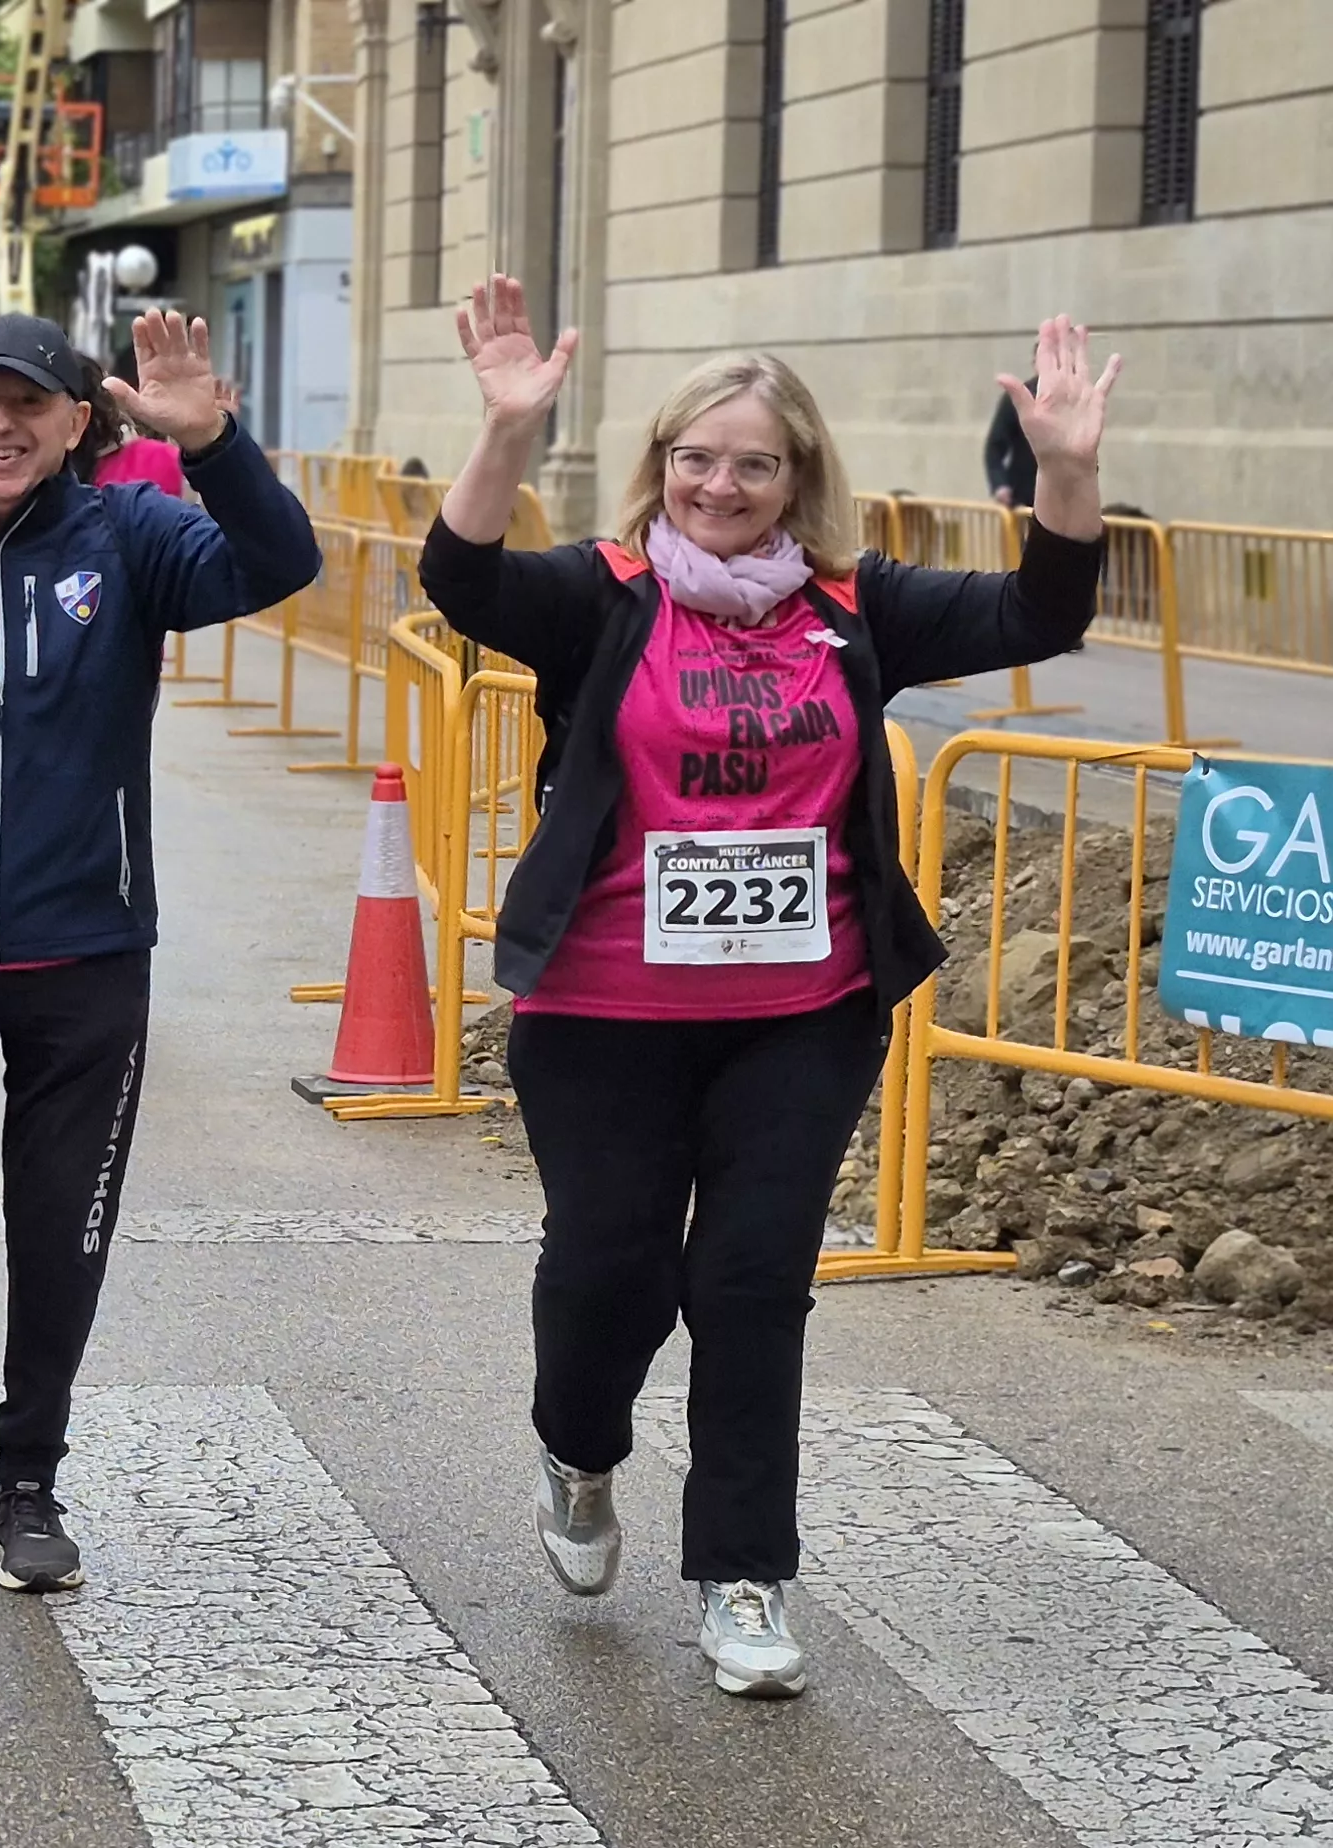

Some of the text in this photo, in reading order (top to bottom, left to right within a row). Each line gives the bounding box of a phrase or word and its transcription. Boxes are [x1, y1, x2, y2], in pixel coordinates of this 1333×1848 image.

[729, 700, 841, 748] EN CADA
[667, 854, 808, 871] CONTRA EL CÁNCER
[718, 846, 761, 857] HUESCA
[665, 876, 810, 925] 2232
[1191, 876, 1333, 924] SERVICIOS
